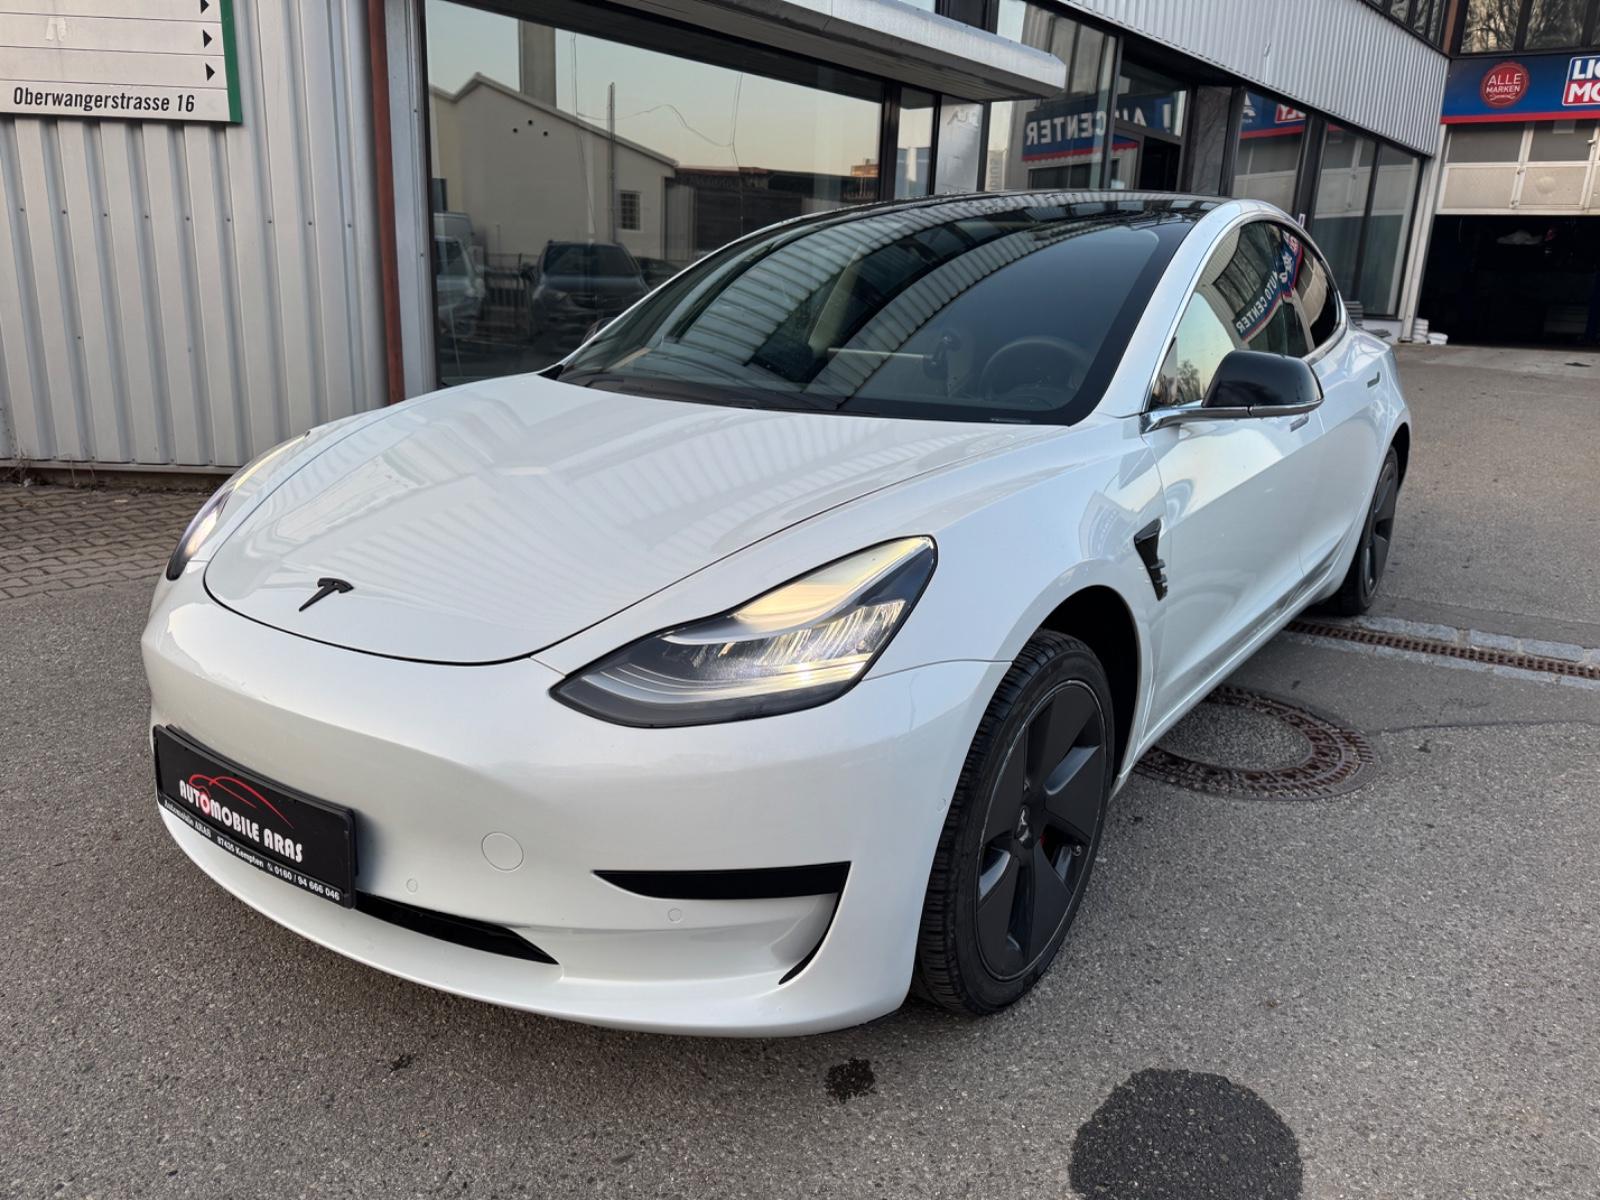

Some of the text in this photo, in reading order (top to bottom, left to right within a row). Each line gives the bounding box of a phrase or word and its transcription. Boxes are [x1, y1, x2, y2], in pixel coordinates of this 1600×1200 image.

[1486, 84, 1521, 94] MARKEN
[1487, 73, 1522, 86] ALLE
[13, 87, 195, 113] Oberwangerstrasse 16
[179, 780, 303, 863] AUTOMOBILE ARAS
